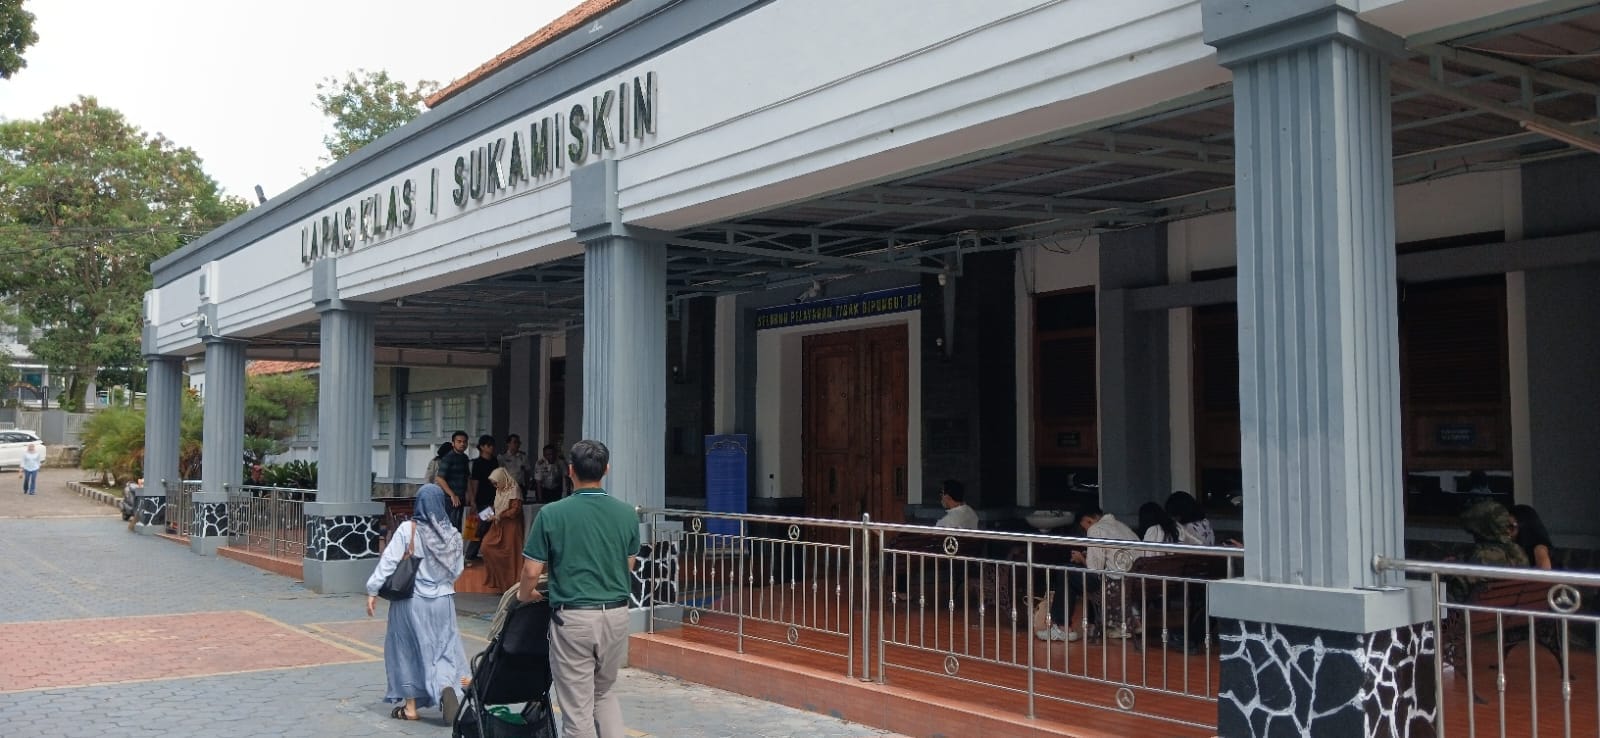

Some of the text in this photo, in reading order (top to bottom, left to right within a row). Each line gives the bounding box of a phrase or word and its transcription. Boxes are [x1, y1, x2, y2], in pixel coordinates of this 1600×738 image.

[301, 71, 658, 266] LAPAS KLAS I SUKAMISKIN
[790, 306, 832, 323] PELAYANAN
[836, 303, 859, 318] TIDAK
[862, 295, 904, 314] DIPUNGUT
